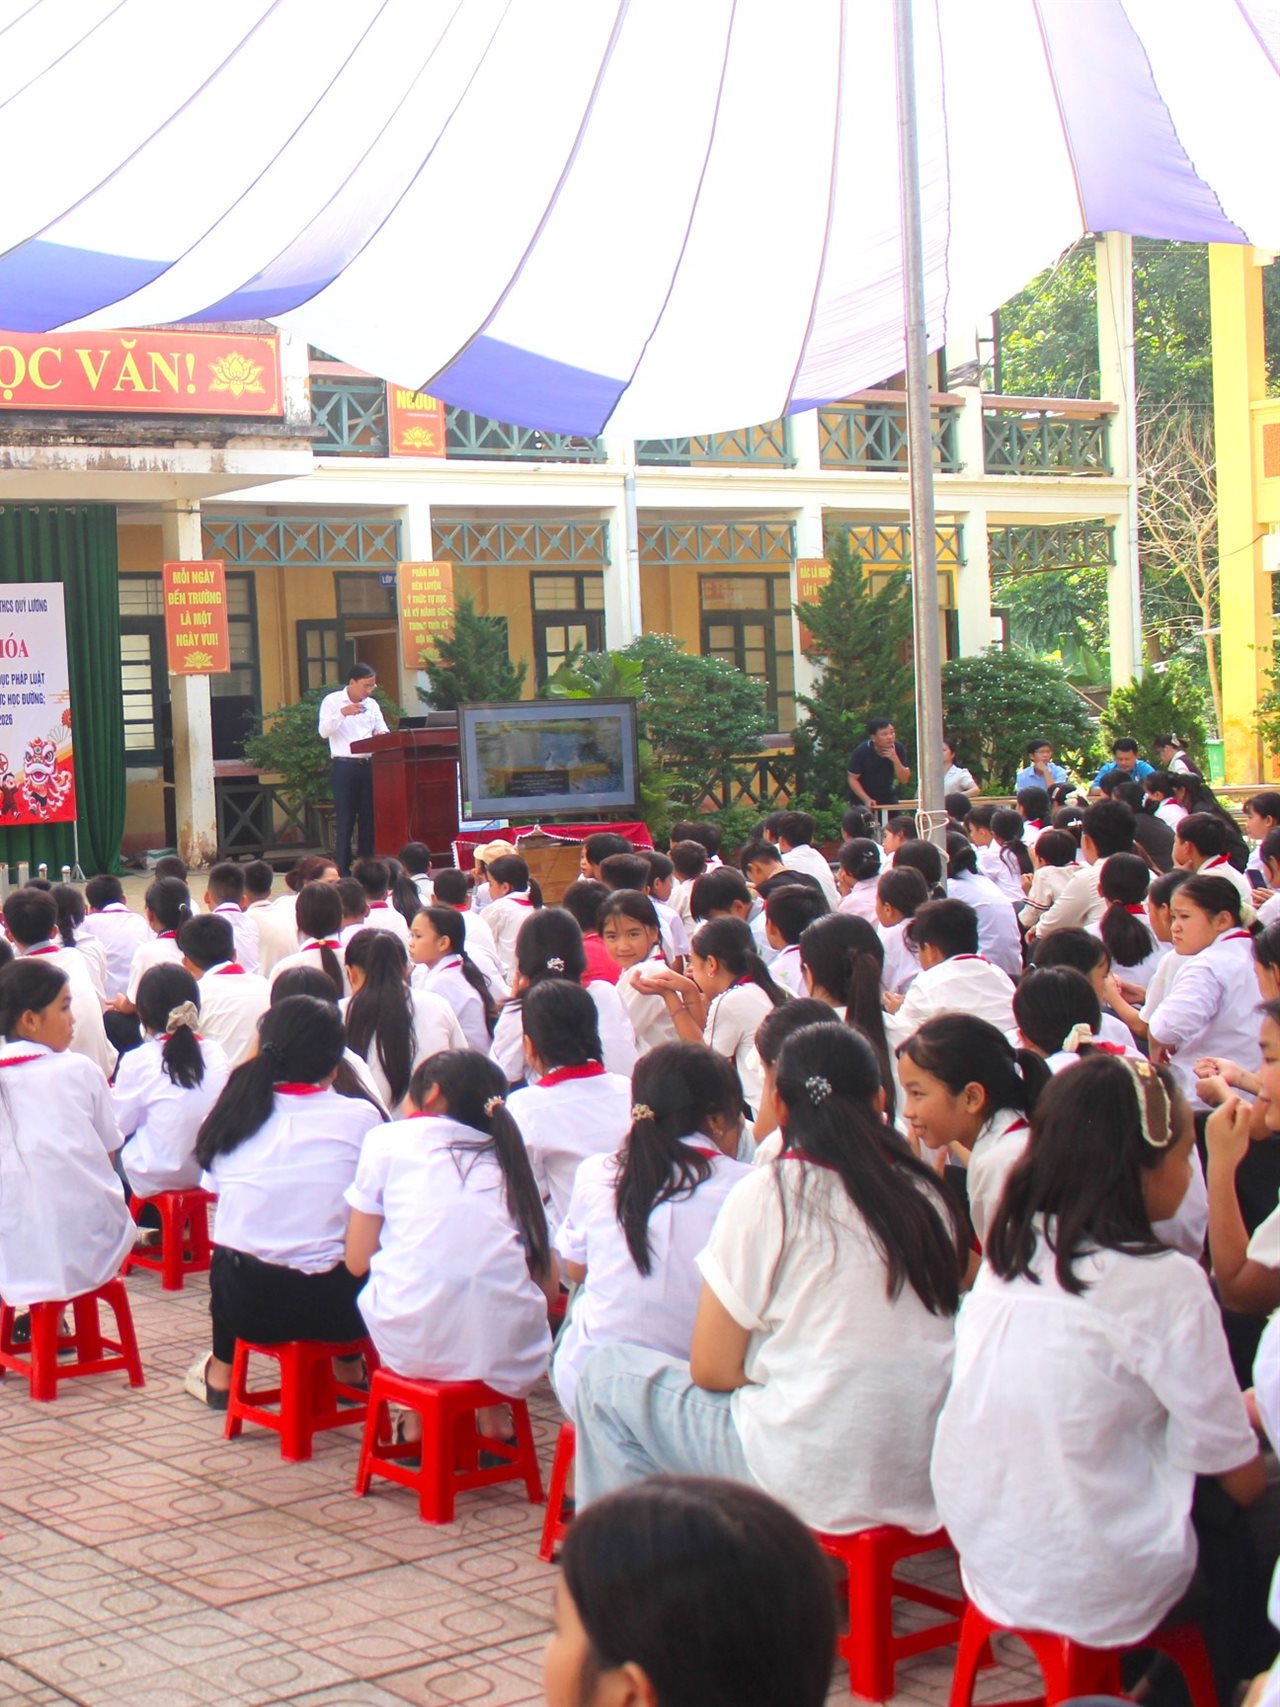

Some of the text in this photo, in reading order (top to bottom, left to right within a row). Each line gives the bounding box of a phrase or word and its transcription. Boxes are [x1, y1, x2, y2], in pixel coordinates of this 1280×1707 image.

[75, 338, 195, 395] VĂN!
[172, 567, 215, 584] MỖI NGÀY
[28, 598, 48, 612] LƯƠNG
[168, 588, 222, 605] ĐẾN TRƯỜNG
[180, 610, 212, 628] LÀ MỘT
[176, 630, 219, 647] NGÀY VUI!
[11, 671, 28, 685] PHÁP
[30, 670, 45, 687] LUẬT
[7, 693, 20, 708] HỌC
